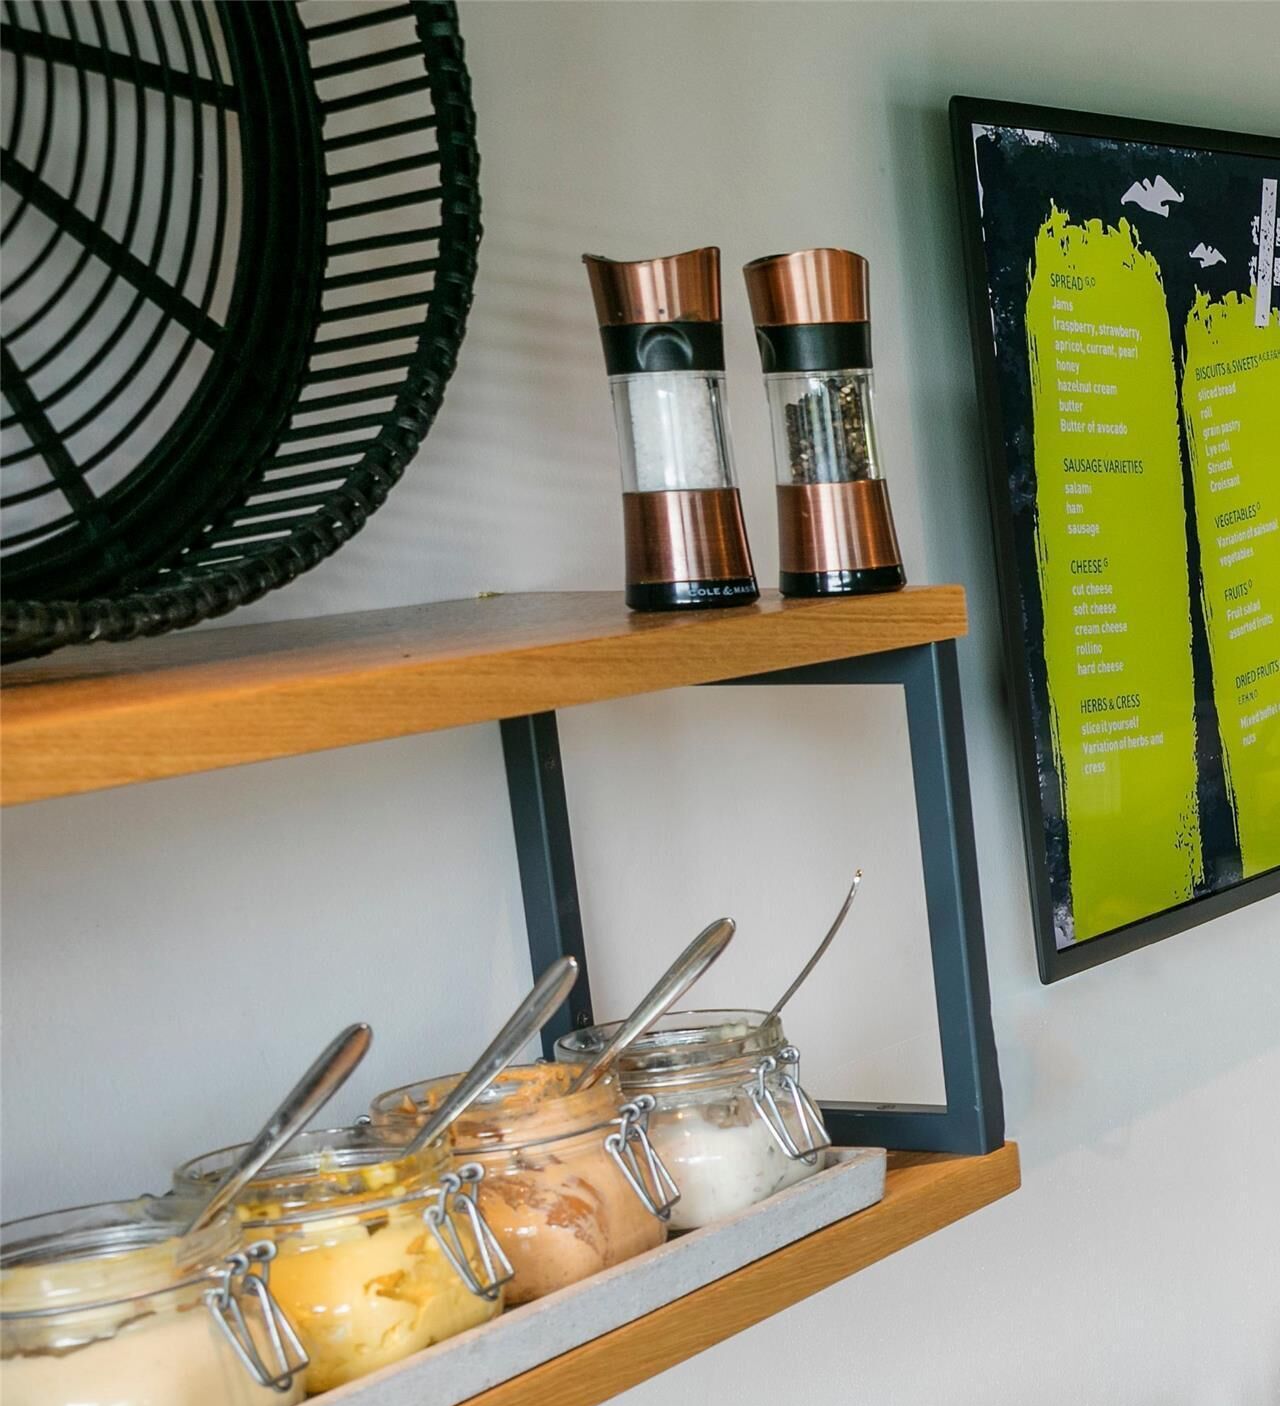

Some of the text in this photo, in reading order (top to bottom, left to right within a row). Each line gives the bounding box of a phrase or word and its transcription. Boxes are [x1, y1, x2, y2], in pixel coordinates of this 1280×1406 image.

[1050, 272, 1083, 290] SPREAD
[1052, 296, 1073, 312] Jams
[1056, 358, 1080, 375] honey
[1195, 362, 1226, 381] BISCUITS
[1226, 363, 1232, 375] &
[1232, 356, 1259, 373] SWEETS
[1057, 378, 1118, 396] hazelnut cream
[1059, 398, 1083, 412] butter
[1200, 405, 1213, 420] roll
[1060, 418, 1128, 435] Butter of avocado
[1218, 438, 1230, 452] roll
[1063, 457, 1144, 474] SAUSAGE VARIETIES
[1064, 481, 1092, 495] salami
[1210, 474, 1241, 493] Croissant
[1065, 501, 1084, 514] ham
[1214, 504, 1257, 528] VEGETABLES
[1067, 523, 1100, 537] sausage
[1071, 559, 1102, 574] CHEESE
[688, 585, 754, 597] COLE & MAS
[1072, 583, 1113, 596] cut cheese
[1224, 582, 1248, 601] FRUITS
[1073, 602, 1117, 616] soft cheese
[1074, 621, 1128, 636] cream cheese
[1077, 660, 1124, 676] hard cheese
[1235, 669, 1257, 689] DRIED
[1257, 659, 1280, 679] FRUITS
[1080, 693, 1140, 714] HERBS & CRESS
[1082, 719, 1100, 736] slice
[1107, 716, 1139, 735] yourself
[1083, 732, 1164, 754] Variation of herbs and
[1084, 761, 1105, 775] cress
